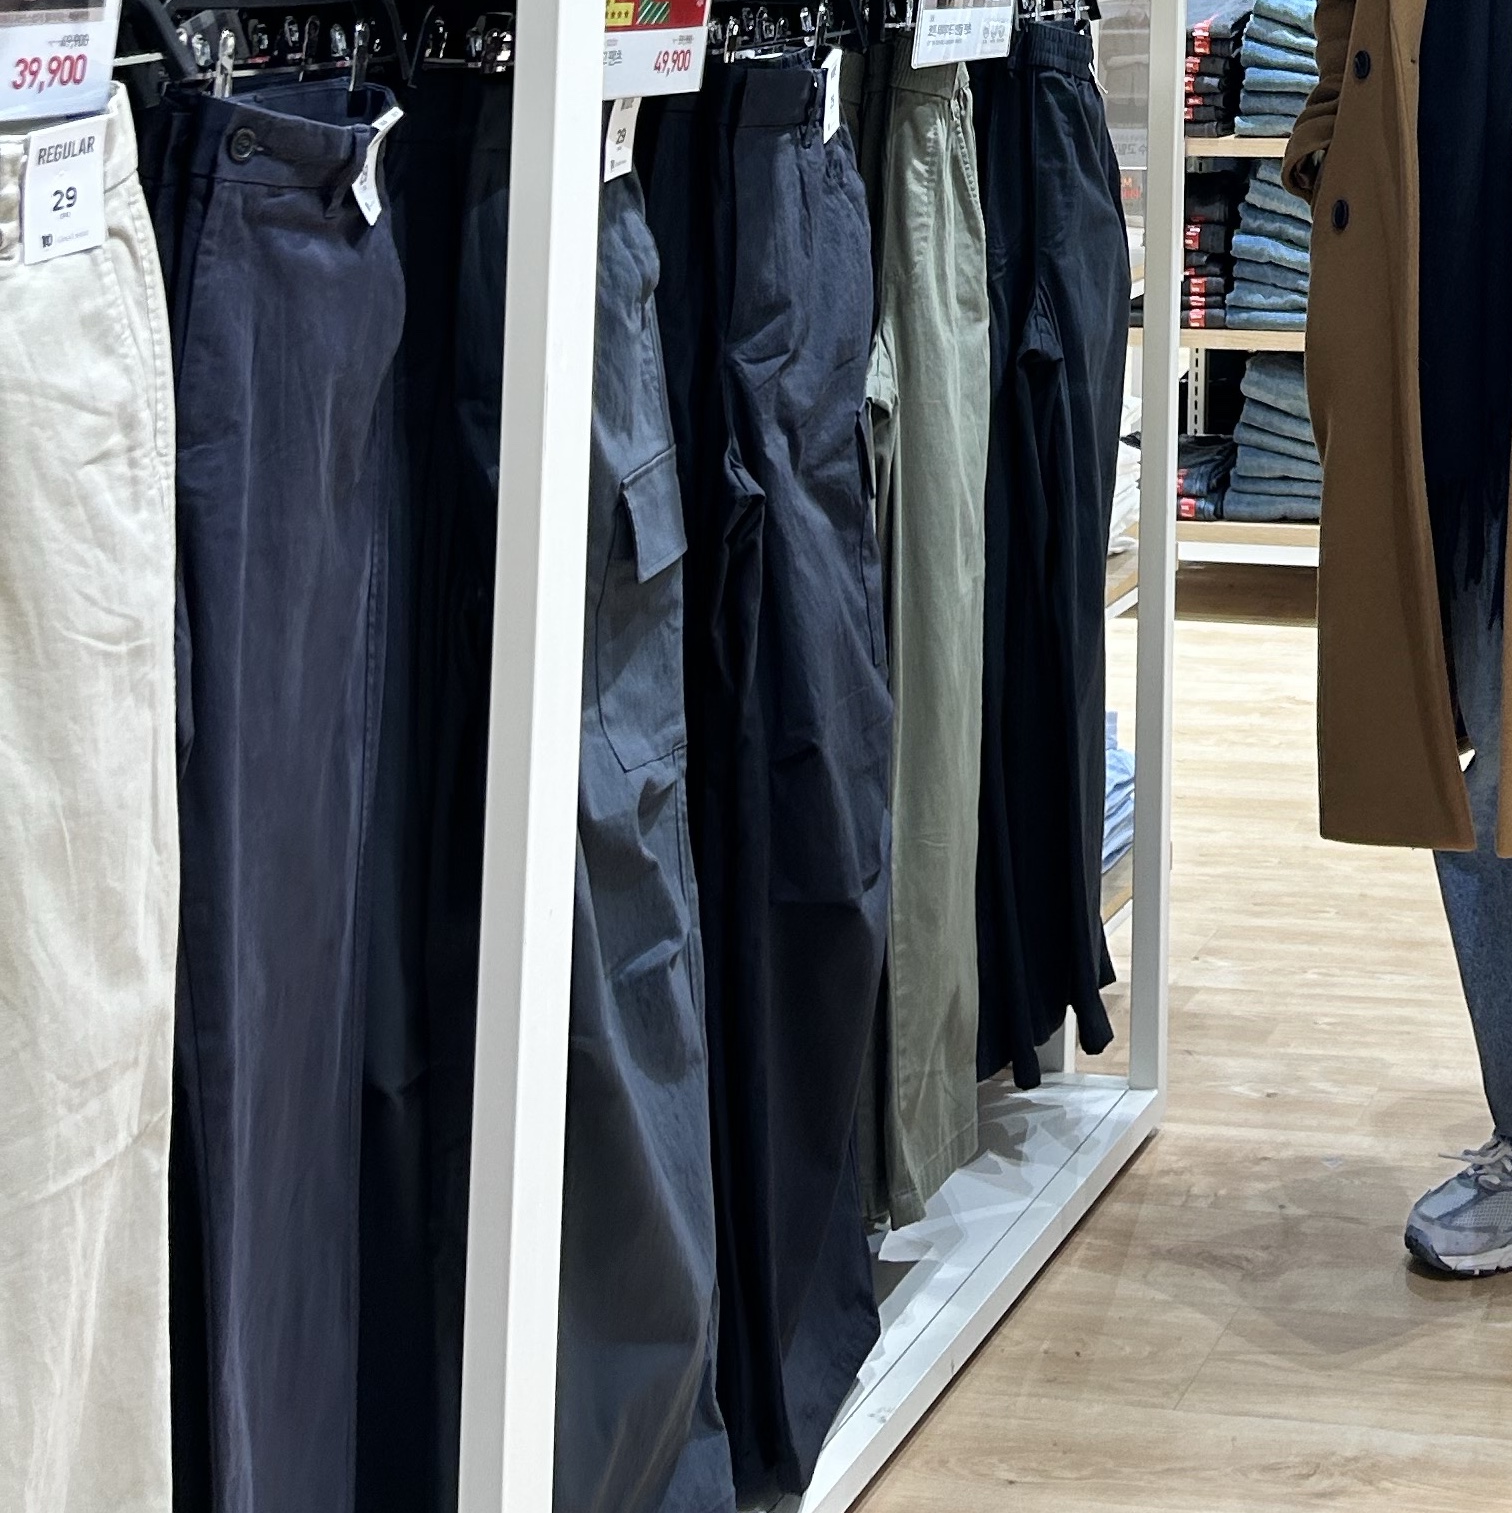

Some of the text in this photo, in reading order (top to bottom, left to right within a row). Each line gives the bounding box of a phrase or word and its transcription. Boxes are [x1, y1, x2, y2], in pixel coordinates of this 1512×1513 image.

[12, 54, 88, 94] 39,900
[654, 49, 692, 77] 49,900
[38, 136, 96, 165] REGULAR
[52, 186, 78, 212] 29
